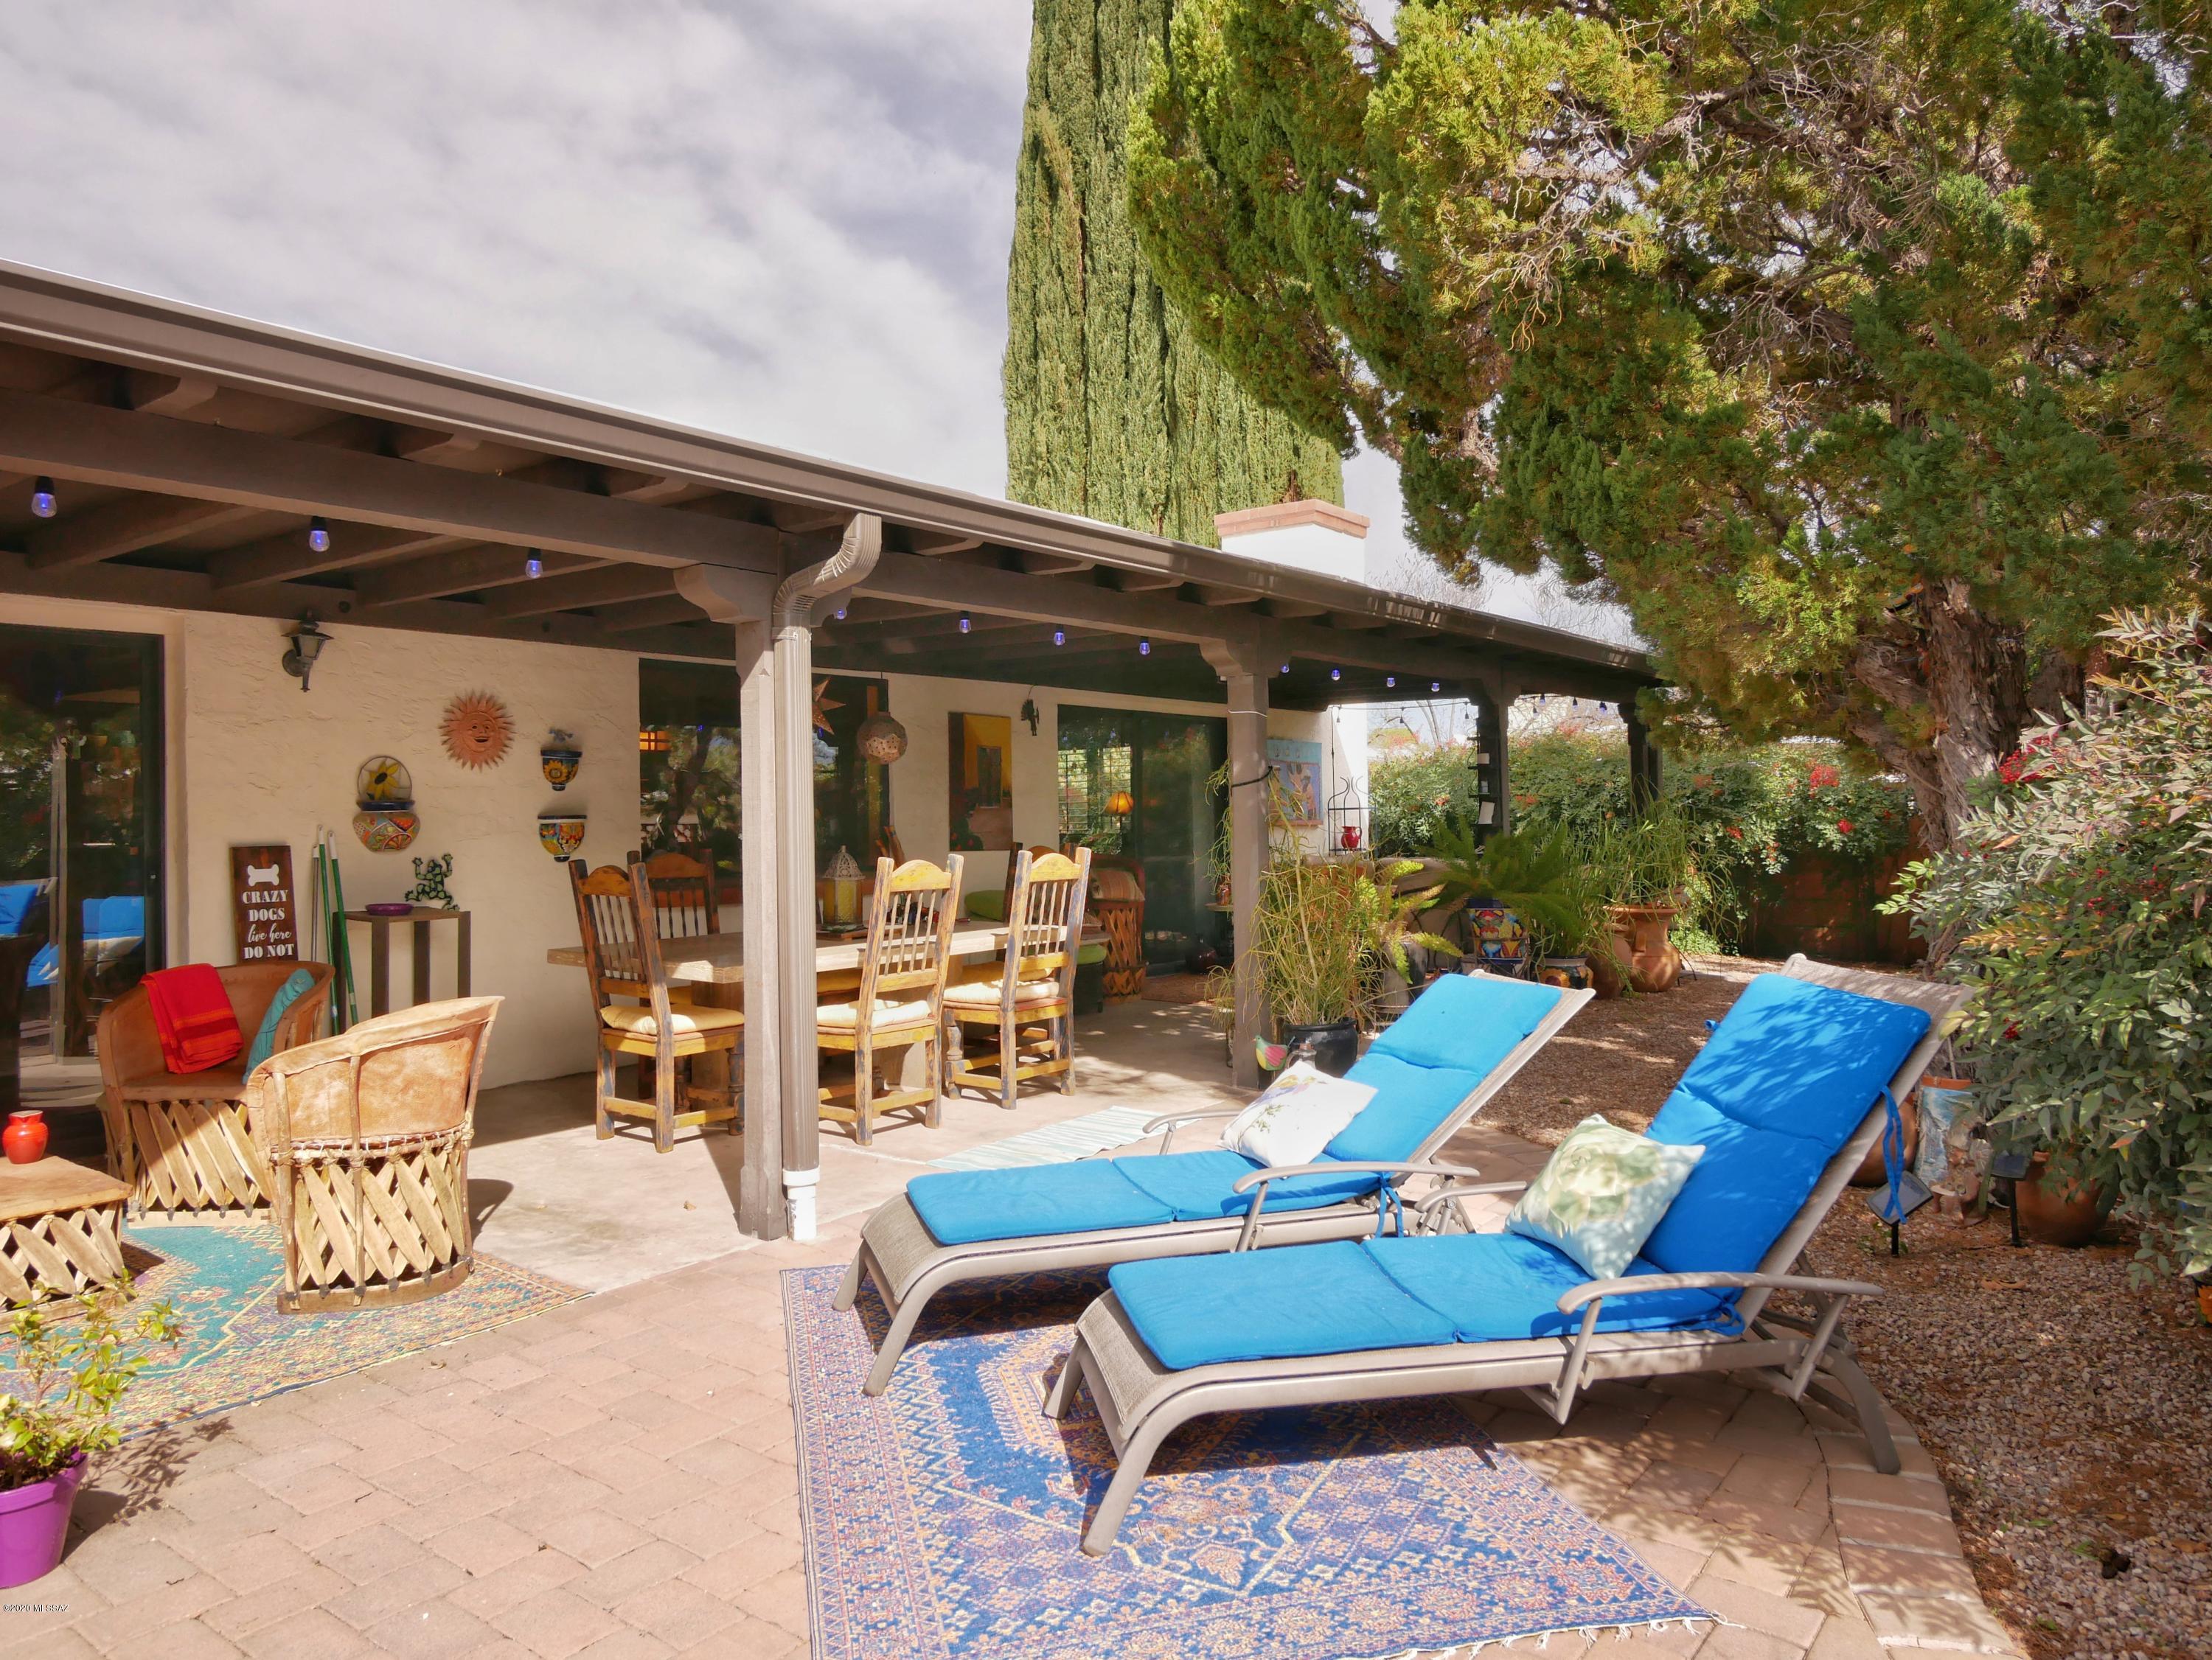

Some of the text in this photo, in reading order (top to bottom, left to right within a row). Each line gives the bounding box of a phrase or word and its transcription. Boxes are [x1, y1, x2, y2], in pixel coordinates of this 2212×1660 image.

[242, 890, 288, 904] CRAZY
[249, 907, 285, 921] DOGS
[248, 923, 291, 943] live here
[244, 944, 294, 959] DO NOT
